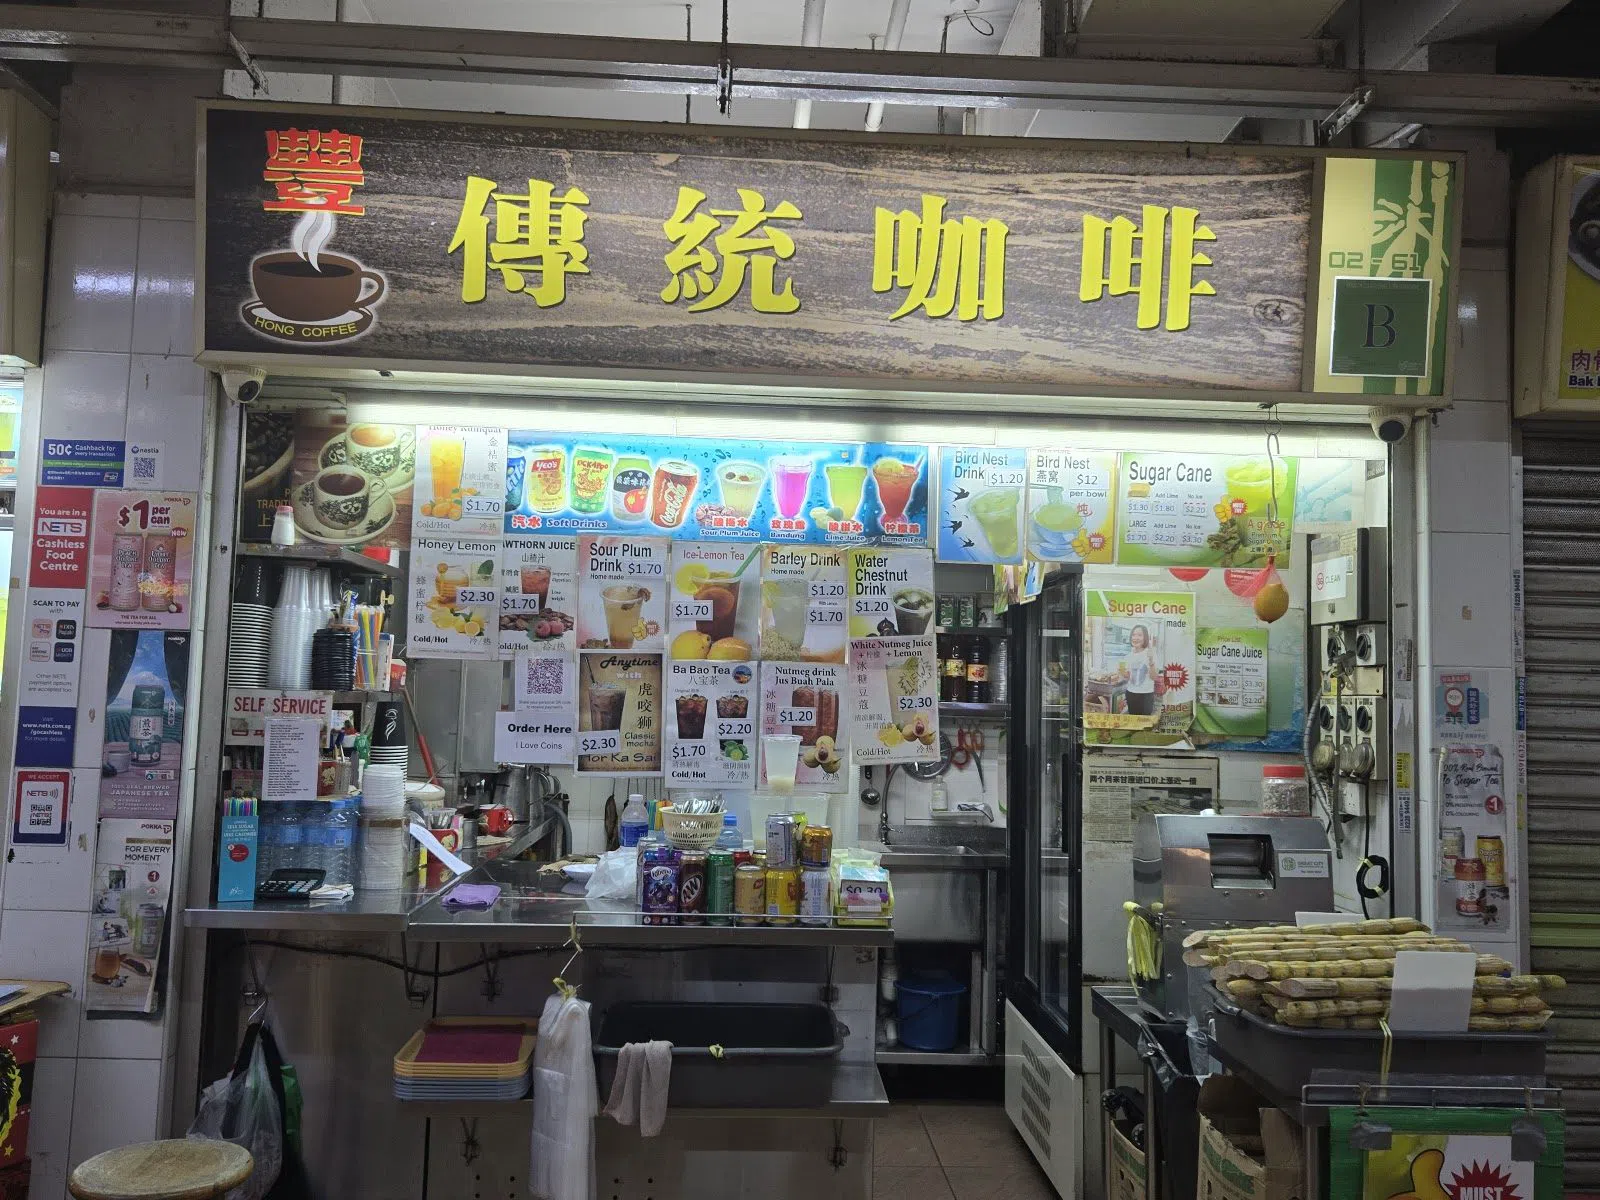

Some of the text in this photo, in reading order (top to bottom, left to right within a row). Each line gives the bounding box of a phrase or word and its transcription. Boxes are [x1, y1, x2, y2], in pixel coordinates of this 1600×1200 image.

[447, 174, 1218, 332] 傳統咖啡
[1329, 251, 1364, 269] 02
[1391, 253, 1420, 271] 61
[254, 316, 358, 337] HONG COFFEE
[1360, 303, 1396, 348] B
[1568, 375, 1594, 387] Bak
[48, 443, 73, 456] 50¢
[75, 444, 105, 452] Cashback
[955, 451, 1009, 466] Bird Nest
[1036, 456, 1090, 470] Bird Nest
[954, 466, 984, 480] Drink
[991, 473, 1024, 486] $1.20
[1036, 470, 1059, 484] 燕窝
[1129, 461, 1212, 485] Sugar Cane
[1076, 474, 1098, 486] $12
[1069, 491, 1084, 499] per
[40, 507, 56, 515] You
[72, 508, 80, 516] in
[466, 499, 500, 512] $1.70
[1128, 502, 1206, 514] $1.30 $1.80 $2.20
[118, 499, 171, 530] $1 per
[150, 515, 170, 525] can
[41, 521, 83, 533] NETS
[416, 520, 451, 529] Cold/Hot
[512, 515, 542, 528] 汽水
[546, 519, 607, 528] Soft Drinks
[1128, 519, 1147, 528] LARGE
[770, 532, 806, 540] Bandung
[846, 534, 866, 542] Juice
[1126, 533, 1202, 543] $1.70 $2.20 $3.30
[36, 538, 85, 549] Cashless
[418, 538, 496, 551] Honey Lemon
[548, 541, 576, 550] JUICE
[589, 542, 652, 557] Sour Plum
[46, 550, 74, 560] Food
[683, 549, 745, 561] Ice-Lemon Tea
[770, 551, 841, 569] Barley Drink
[855, 554, 889, 568] Water
[39, 560, 79, 571] Centre
[590, 558, 622, 572] Drink
[628, 562, 662, 575] $1.70
[855, 568, 908, 582] Chestnut
[811, 584, 844, 597] $1.20
[855, 582, 887, 596] Drink
[32, 599, 53, 607] SCAN
[460, 590, 495, 603] $2.30
[502, 597, 537, 610] $1.70
[855, 601, 889, 613] $1.20
[1108, 599, 1187, 616] Sugar Cane
[675, 604, 709, 617] $1.70
[809, 610, 843, 623] $1.70
[1166, 619, 1187, 628] made
[413, 635, 448, 643] Cold/Hot
[850, 639, 933, 650] White Nutmeg Juice
[1197, 644, 1263, 659] Sugar Cane Juice
[600, 655, 659, 671] Anytime
[616, 671, 642, 680] with
[672, 665, 731, 675] Ba Bao Tea
[775, 666, 837, 678] Nutmeg drink
[1166, 670, 1182, 678] MUST
[688, 675, 719, 686] 八宝茶
[774, 676, 834, 686] Jus Buah Pala
[233, 696, 327, 715] SELF SERVICE
[636, 682, 653, 730] 虎咬狮
[900, 697, 933, 709] $2.30
[780, 710, 813, 723] $1.20
[507, 723, 572, 734] Order Here
[718, 723, 752, 736] $2.20
[624, 732, 656, 740] Classic
[520, 741, 539, 749] Love
[540, 741, 563, 750] Coins
[582, 737, 617, 752] $2.30
[611, 752, 629, 763] Ka
[672, 745, 706, 759] $1.70
[856, 748, 891, 757] Cold/Hot
[671, 771, 706, 779] Cold/Hot
[1453, 773, 1499, 787] Sugar Tea
[125, 845, 142, 853] FOR
[1460, 1186, 1503, 1200] MUST
